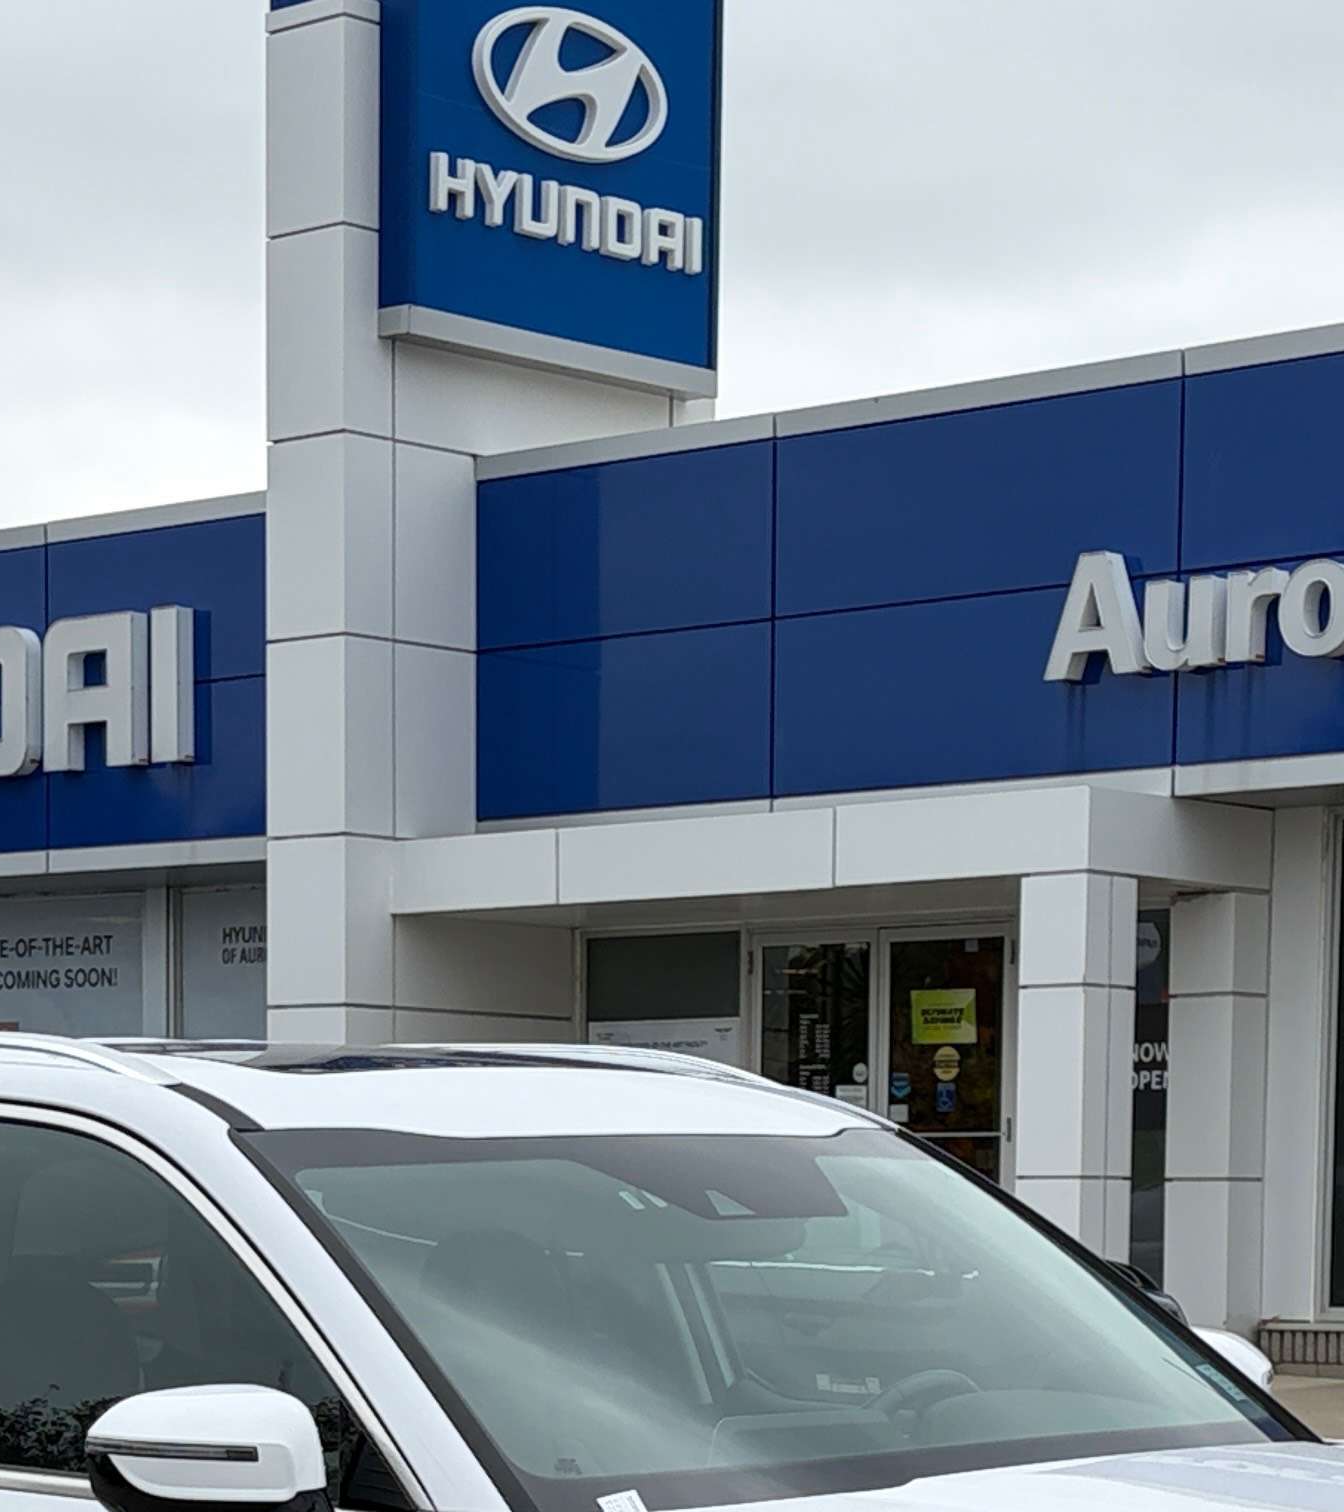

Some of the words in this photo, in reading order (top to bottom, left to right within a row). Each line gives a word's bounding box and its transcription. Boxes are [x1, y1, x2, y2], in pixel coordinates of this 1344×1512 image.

[430, 152, 703, 275] HYUNDAI
[222, 947, 237, 964] OF
[64, 967, 118, 988] SOON!
